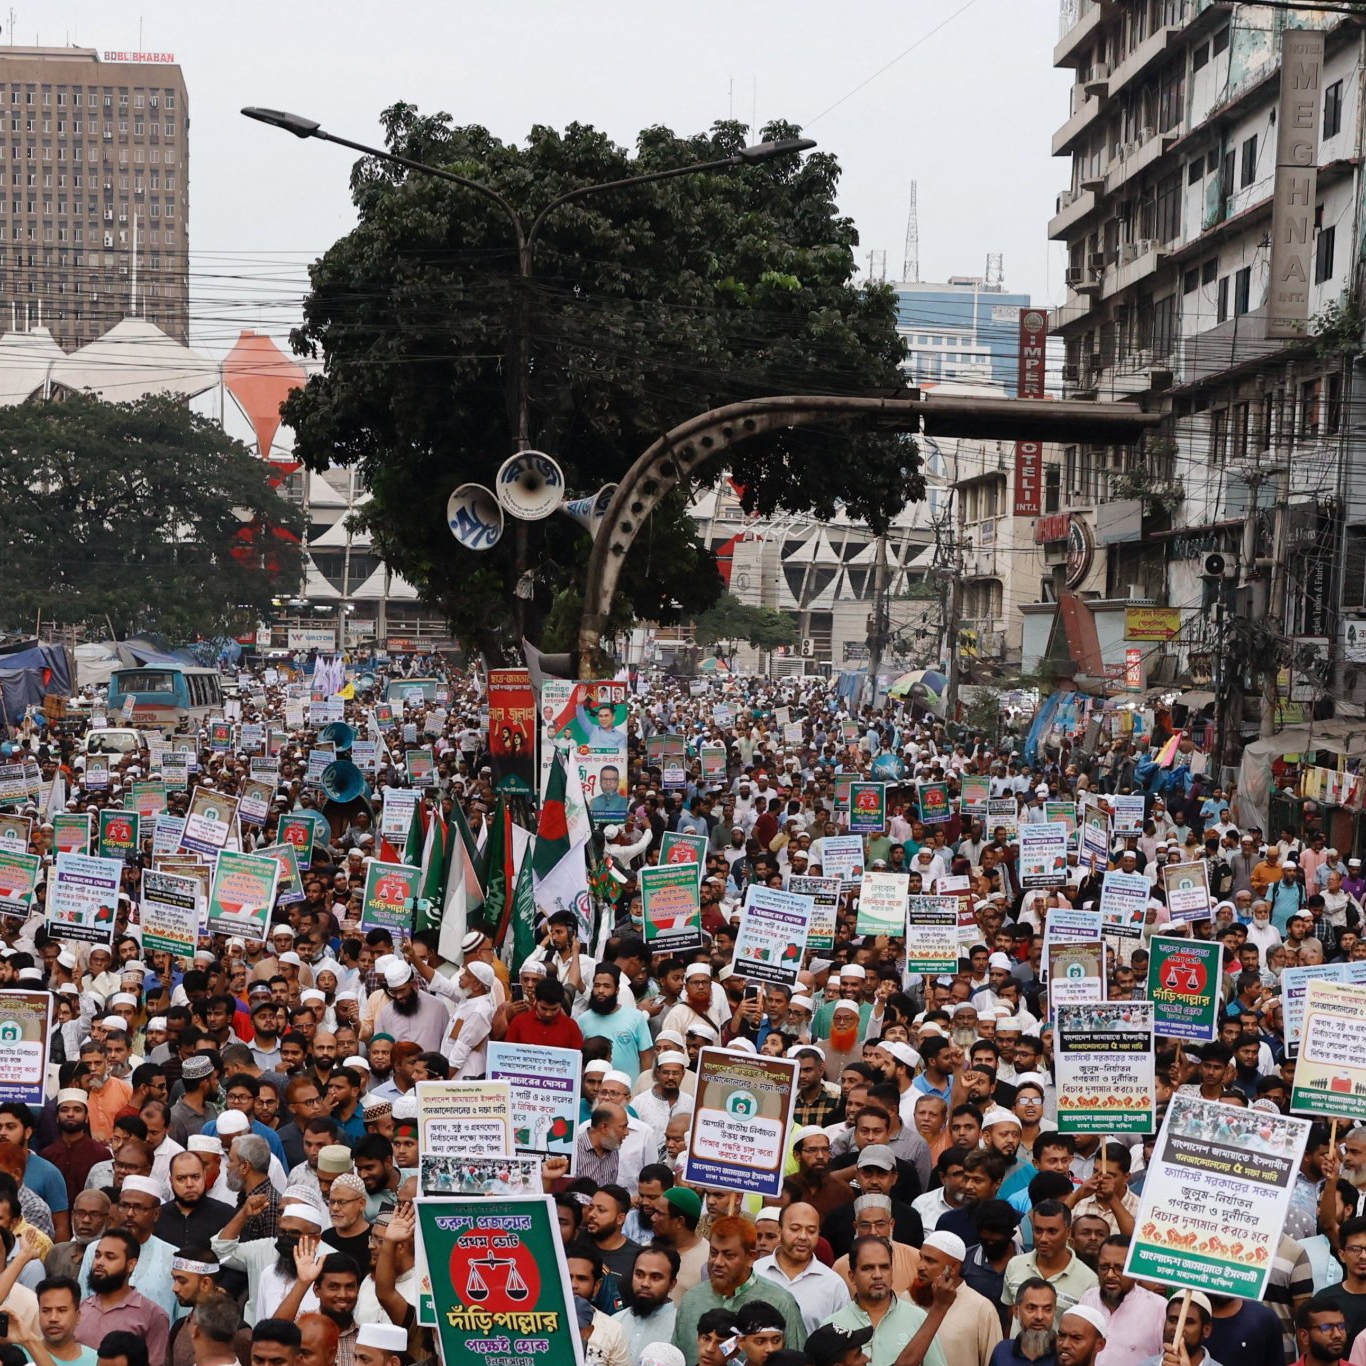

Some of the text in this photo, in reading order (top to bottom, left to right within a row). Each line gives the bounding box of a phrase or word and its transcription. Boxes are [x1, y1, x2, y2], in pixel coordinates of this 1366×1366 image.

[1289, 42, 1323, 54] HOTEL
[104, 51, 175, 63] BDBL BHABAN
[434, 1215, 531, 1231] তরুণ প্রজন্মের
[457, 1233, 519, 1248] প্রথম ভোট
[446, 1305, 558, 1335] দাঁড়িপাল্লার
[465, 1334, 549, 1355] পক্ষেই হোক
